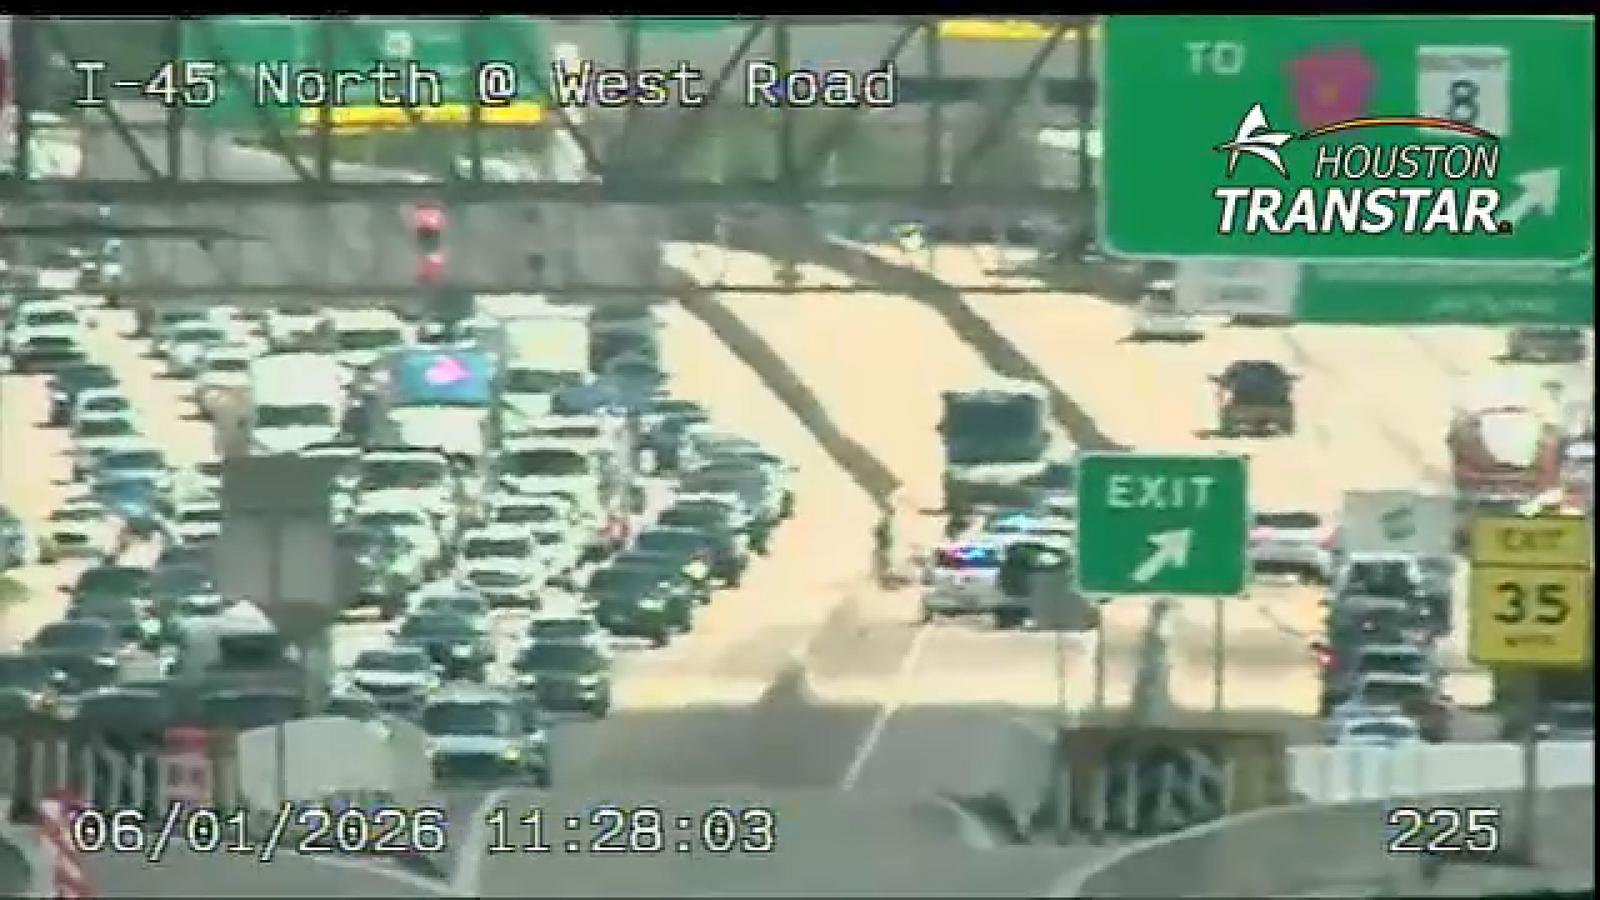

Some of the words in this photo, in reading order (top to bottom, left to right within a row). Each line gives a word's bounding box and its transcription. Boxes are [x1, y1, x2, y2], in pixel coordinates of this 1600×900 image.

[1185, 41, 1246, 75] TO
[1106, 474, 1216, 510] EXIT
[1494, 582, 1570, 625] 35
